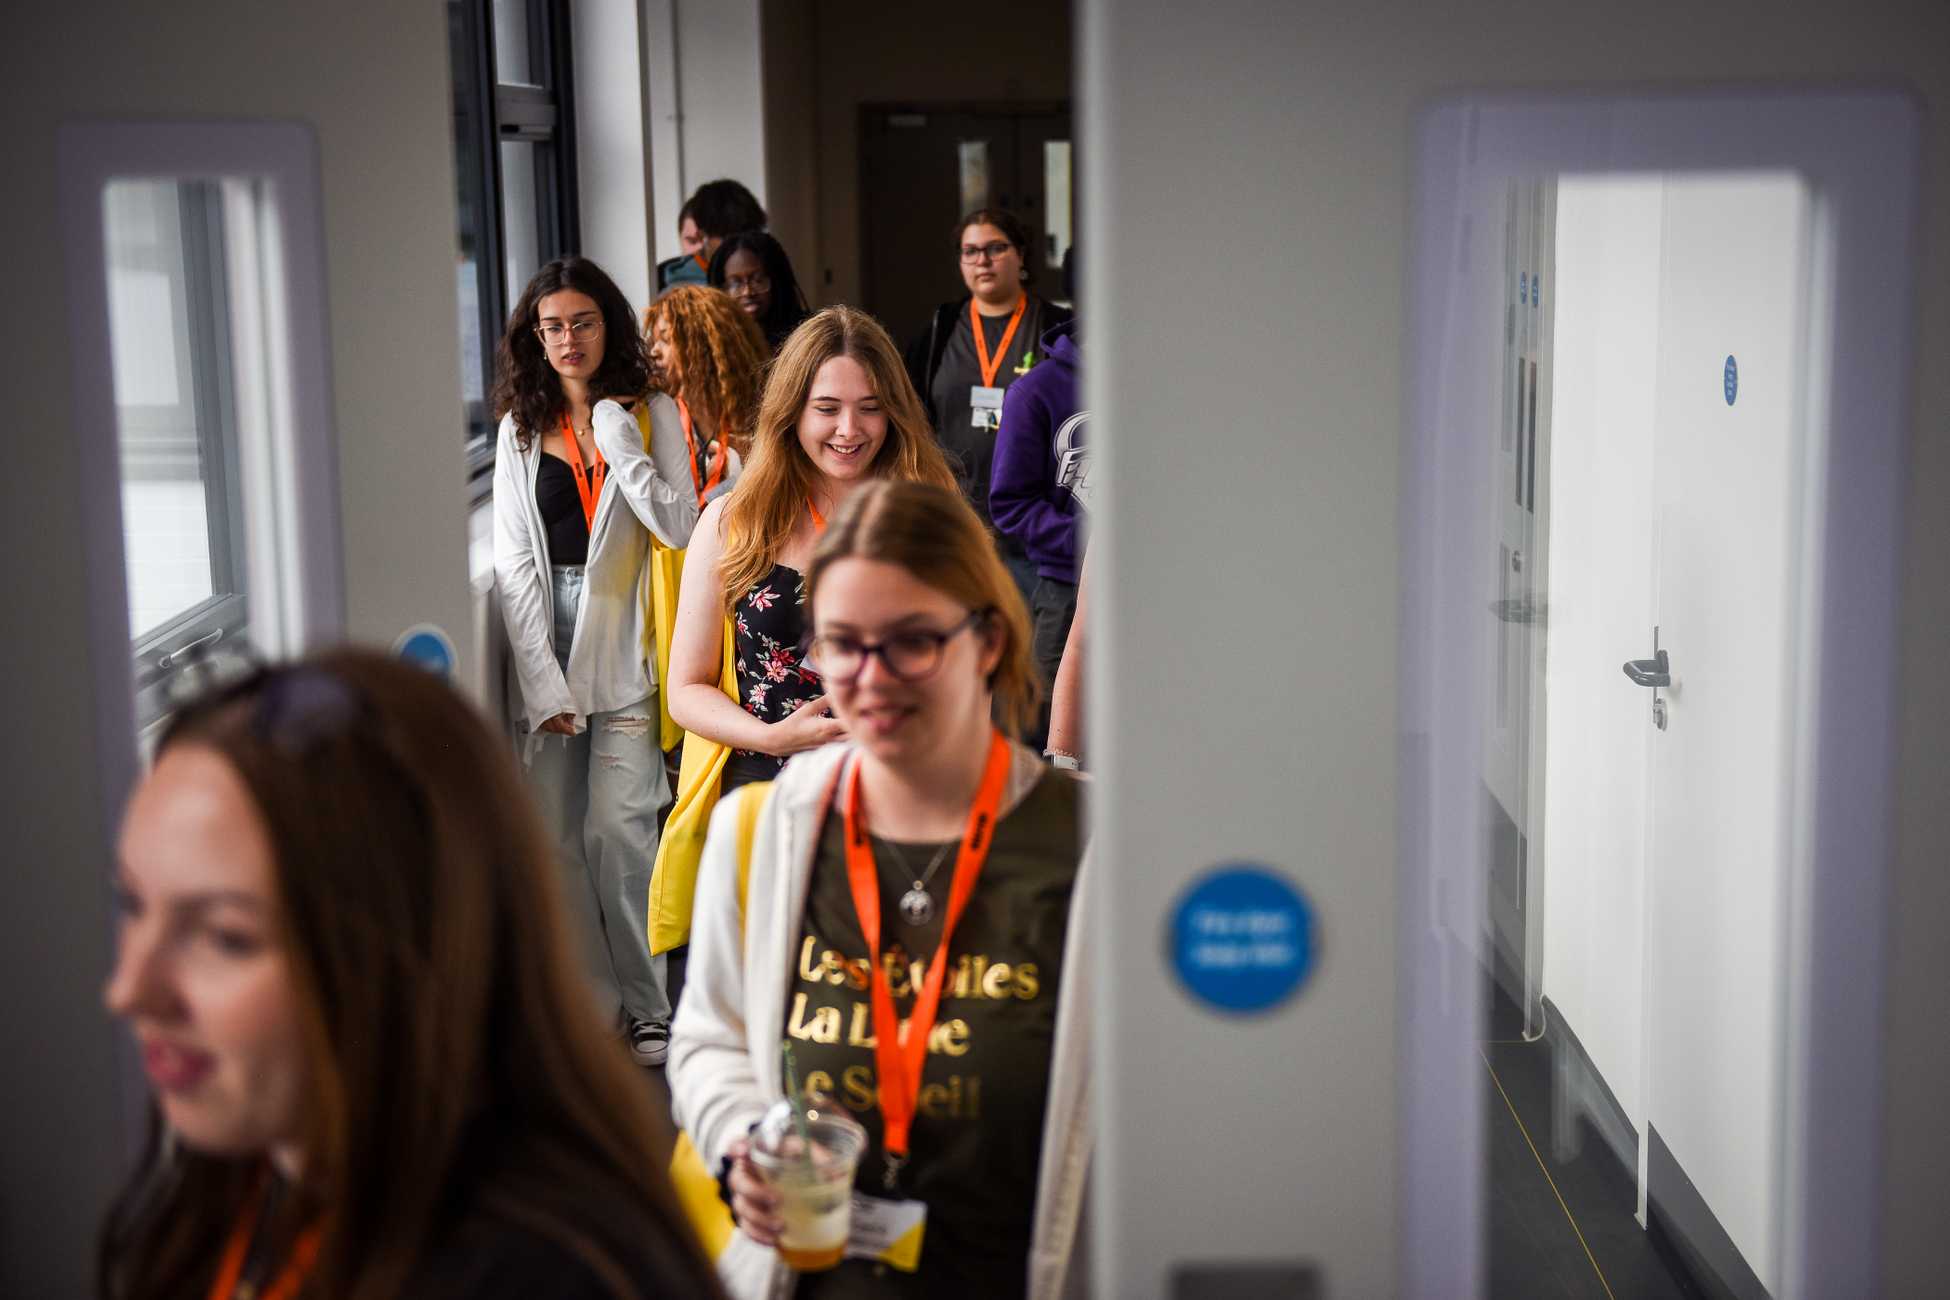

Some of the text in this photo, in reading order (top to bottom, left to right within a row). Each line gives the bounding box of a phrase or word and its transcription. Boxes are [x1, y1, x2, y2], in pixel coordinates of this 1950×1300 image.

[799, 935, 871, 991] Les
[789, 992, 841, 1044] La
[841, 1065, 981, 1120] Seil
